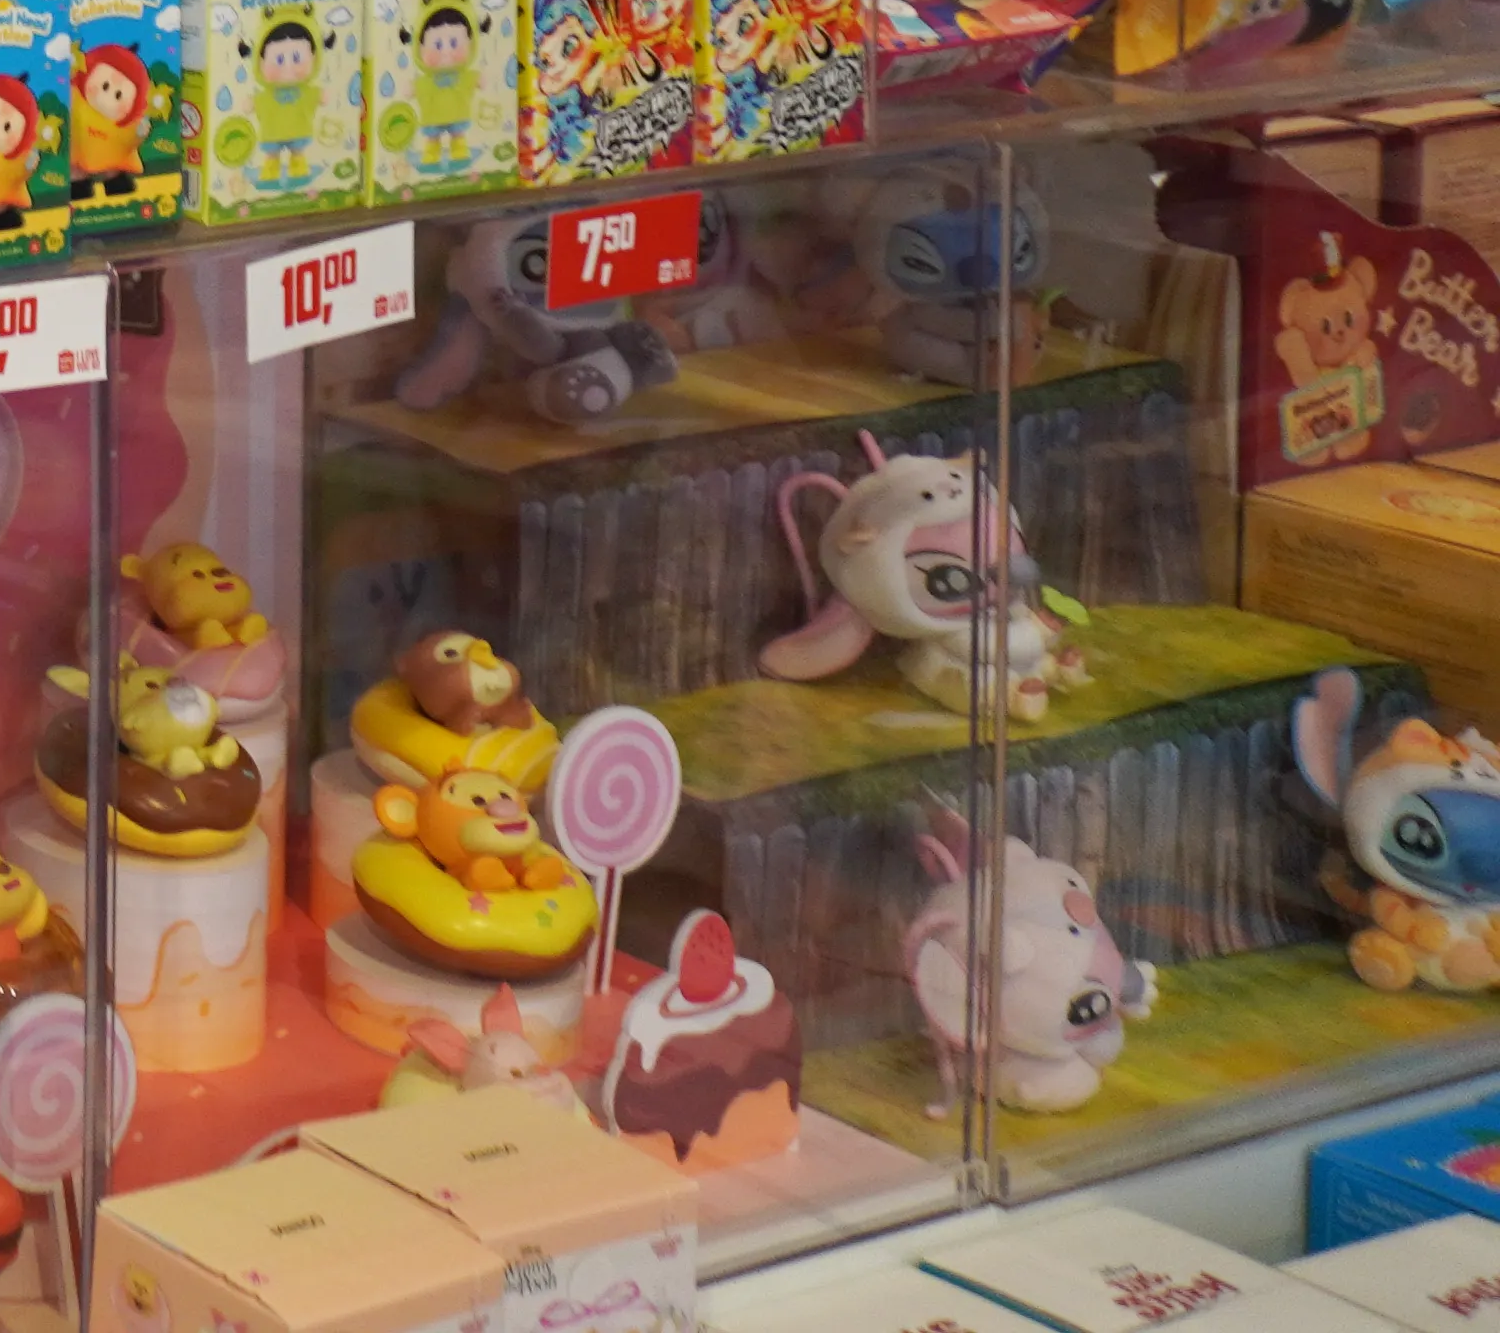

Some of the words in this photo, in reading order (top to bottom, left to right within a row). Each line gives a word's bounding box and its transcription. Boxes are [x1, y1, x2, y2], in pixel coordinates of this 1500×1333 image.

[281, 249, 357, 328] 10,00
[577, 213, 636, 287] 7,50
[1400, 307, 1479, 387] Bear
